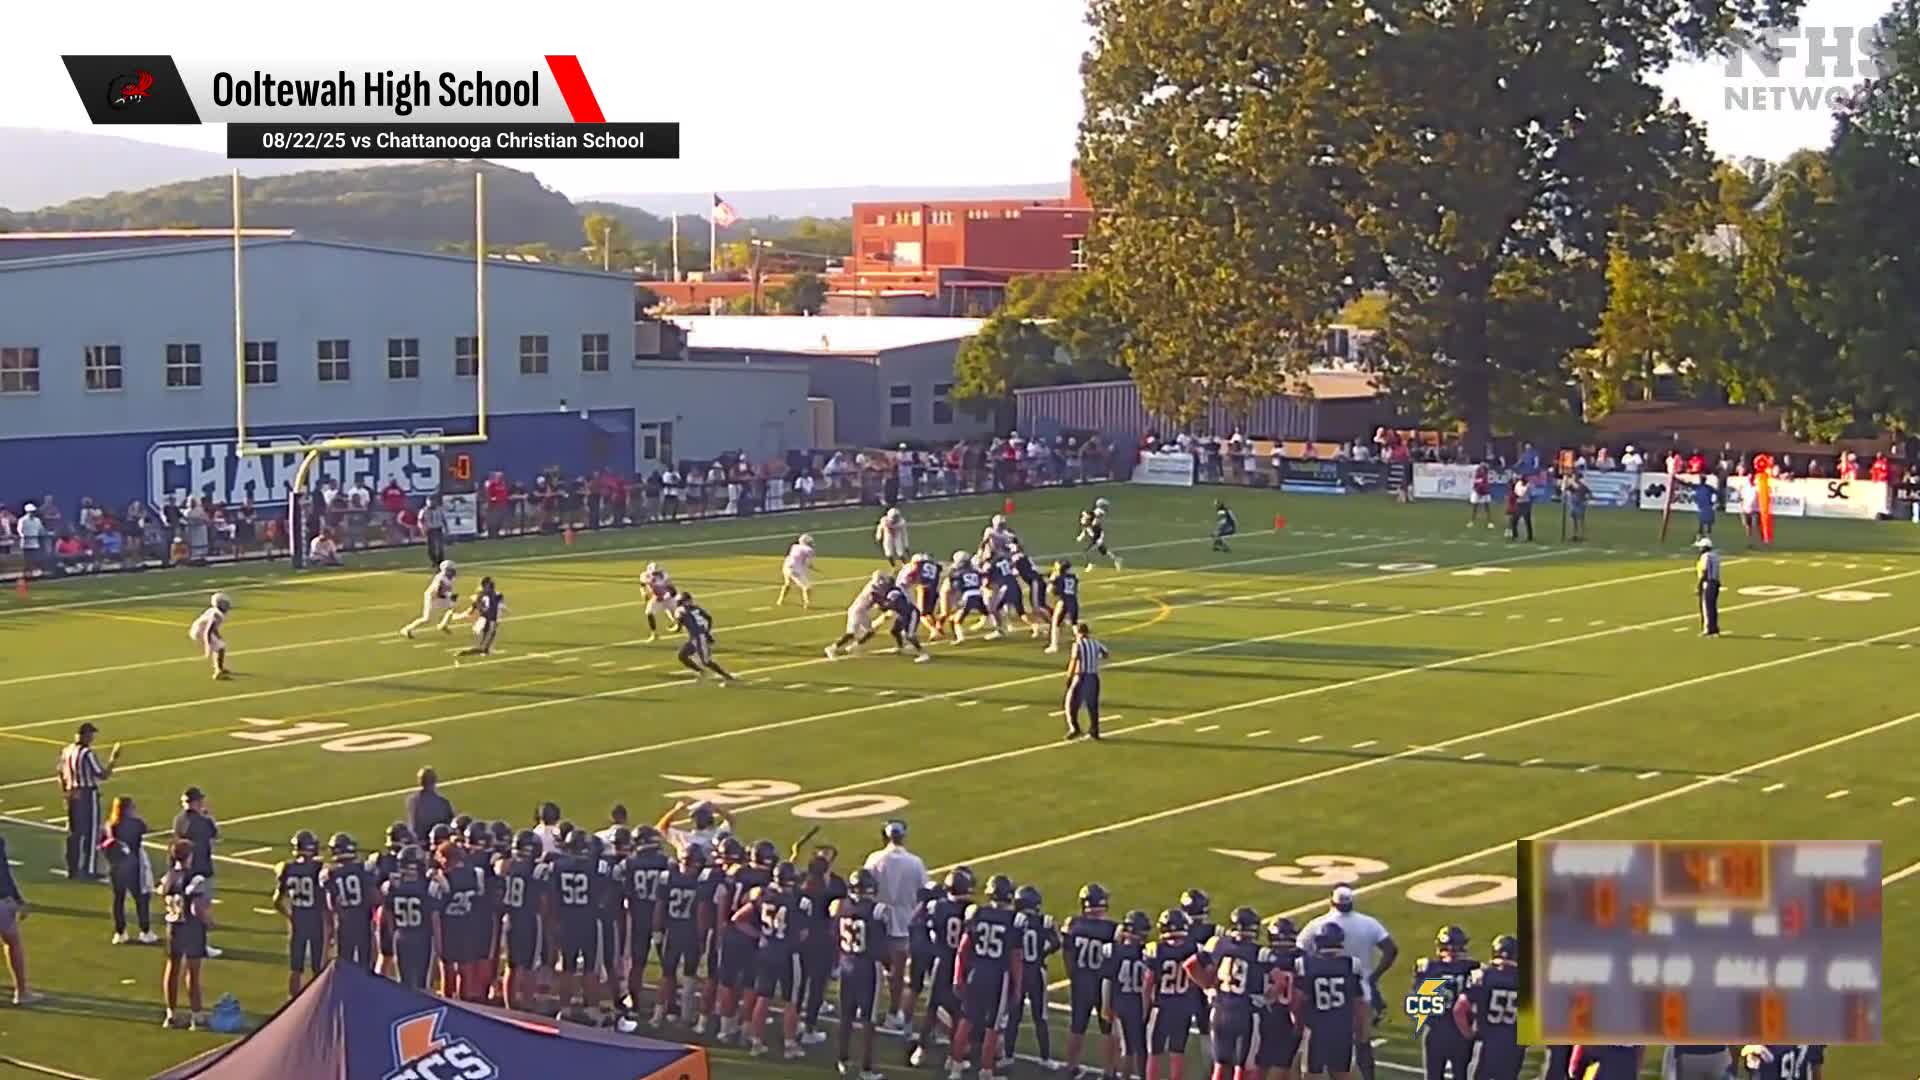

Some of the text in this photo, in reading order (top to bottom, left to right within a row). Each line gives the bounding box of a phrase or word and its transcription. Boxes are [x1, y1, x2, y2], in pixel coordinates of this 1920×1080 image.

[152, 433, 441, 505] CHARGERS
[287, 876, 314, 908] 29
[335, 875, 362, 907] 19
[560, 872, 589, 905] 52
[633, 869, 659, 901] 87
[394, 897, 422, 927] 56
[668, 887, 697, 919] 27
[761, 902, 788, 939] 54
[839, 916, 866, 953] 53
[975, 922, 1006, 958] 35
[1075, 936, 1102, 970] 70
[1117, 959, 1145, 994] 40
[1160, 959, 1190, 994] 20
[1217, 955, 1249, 995] 49
[1314, 976, 1345, 1011] 65
[1487, 988, 1518, 1025] 55
